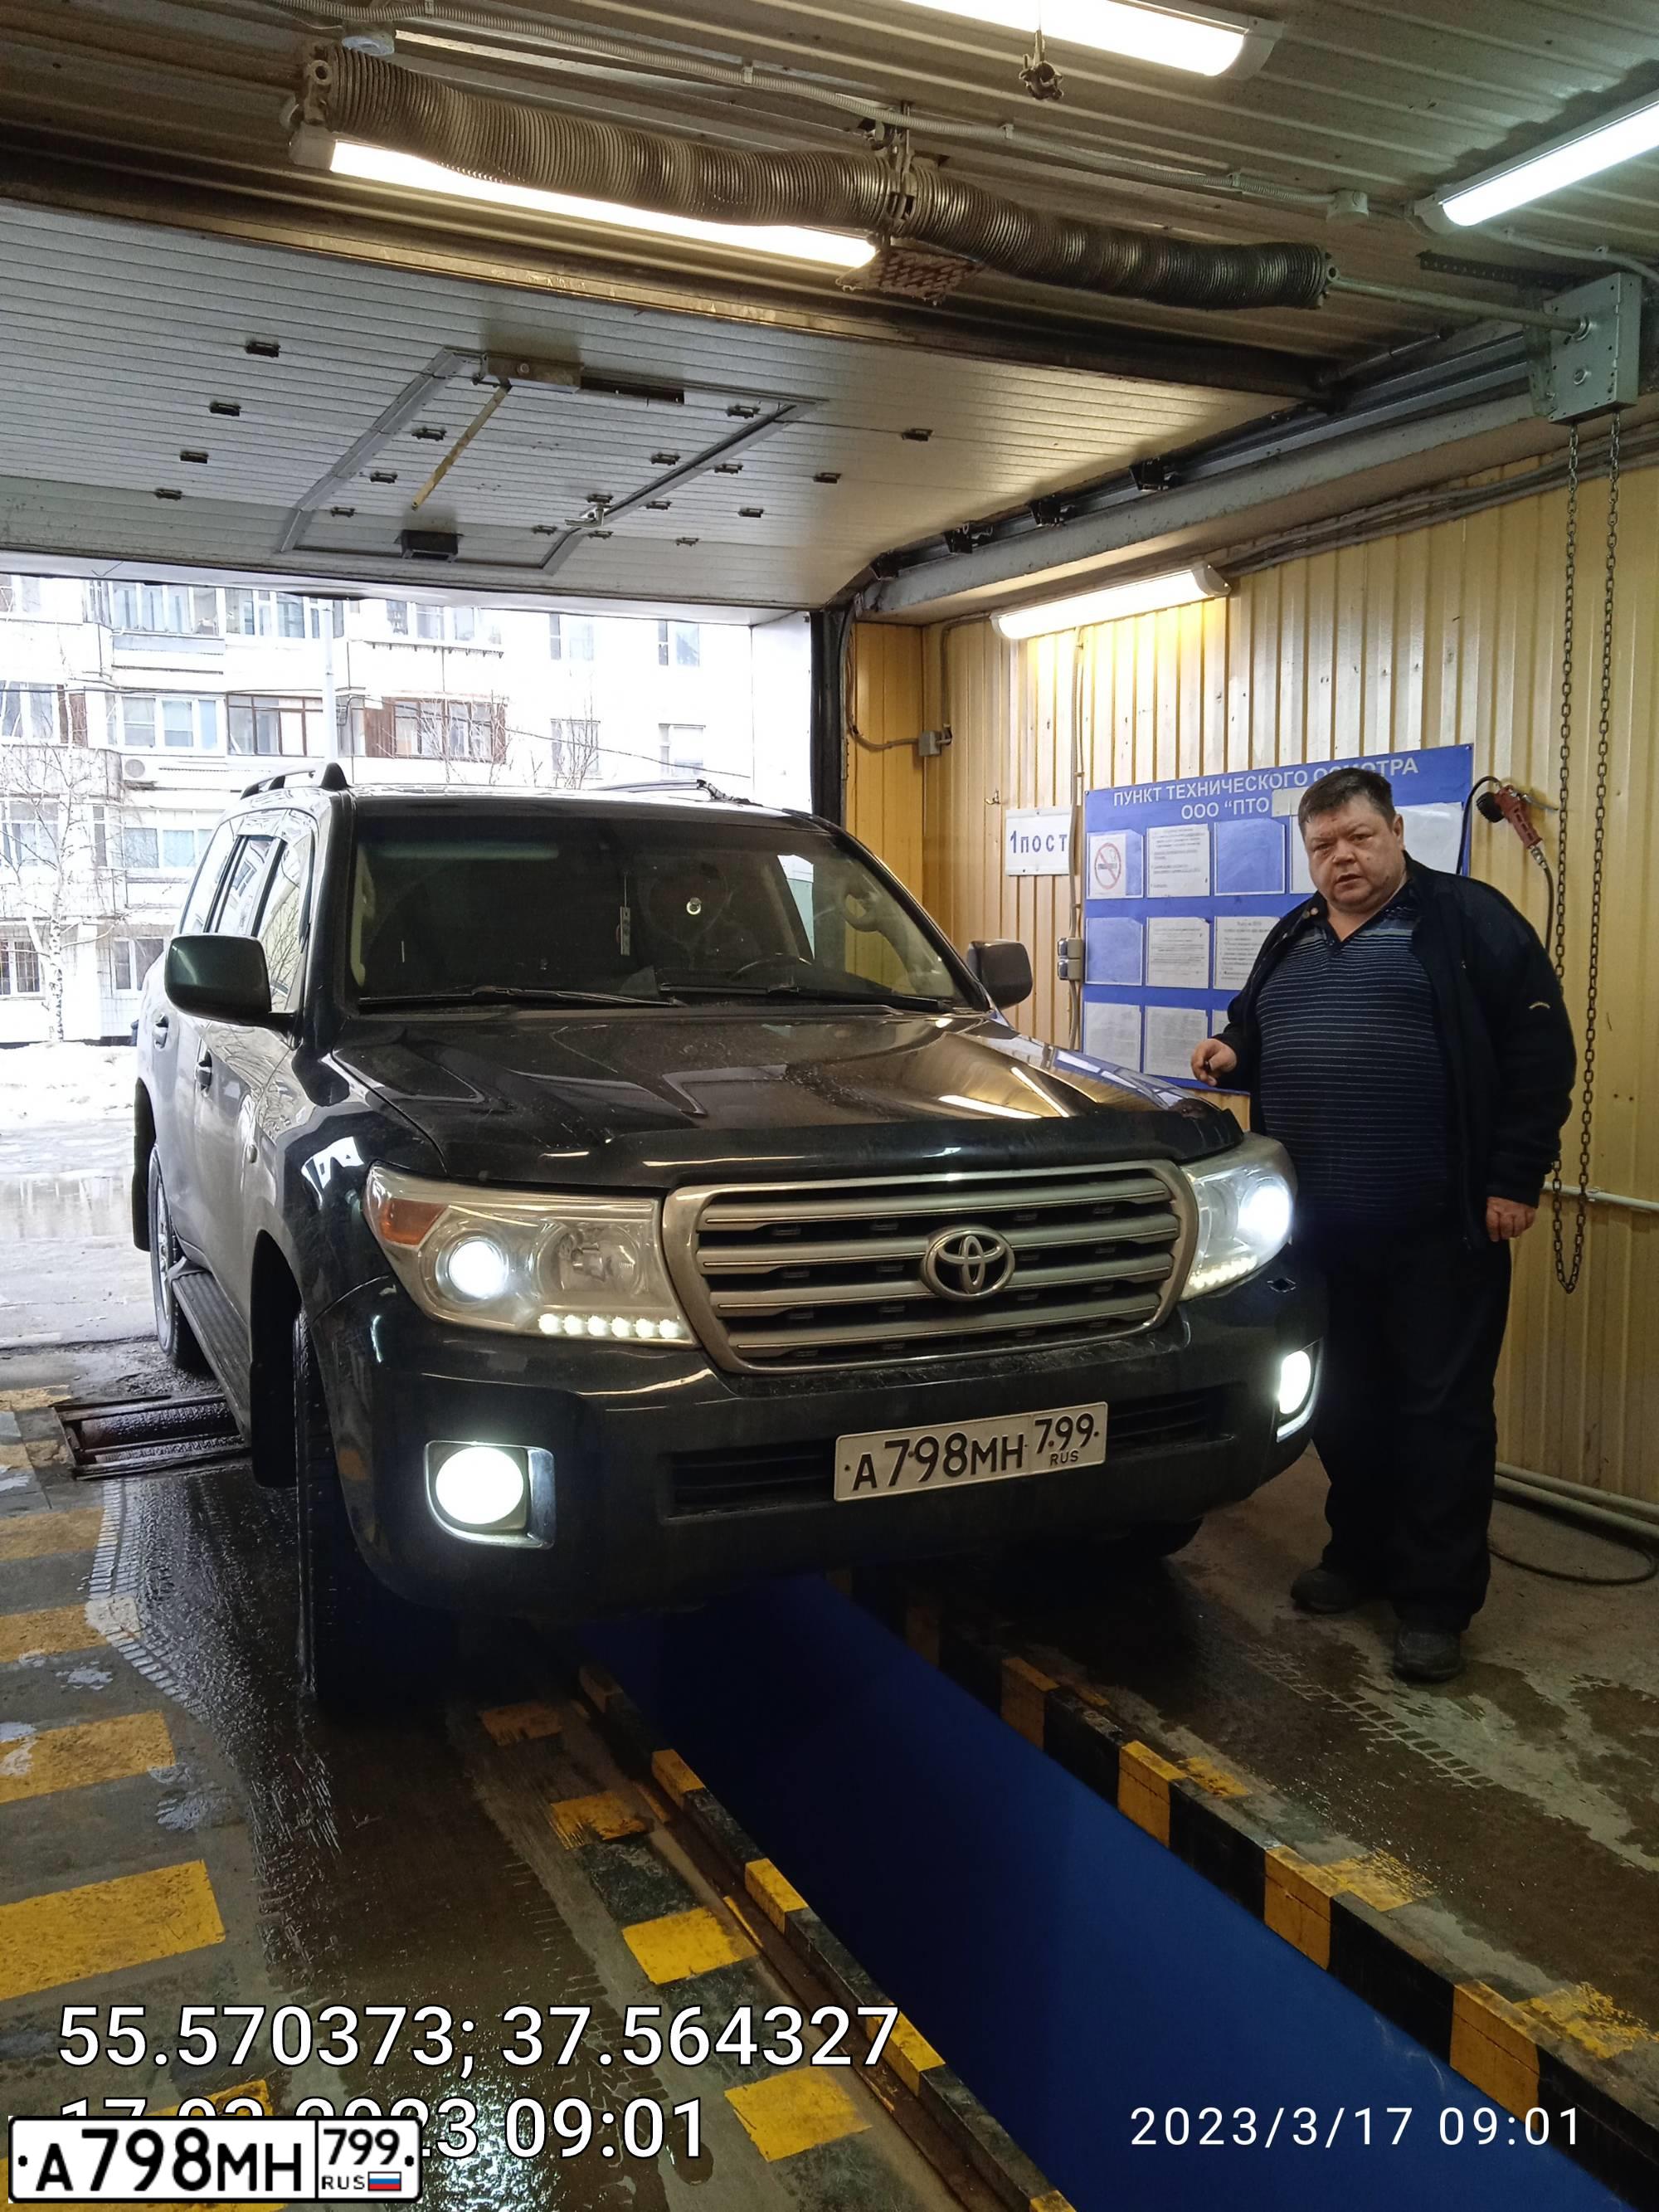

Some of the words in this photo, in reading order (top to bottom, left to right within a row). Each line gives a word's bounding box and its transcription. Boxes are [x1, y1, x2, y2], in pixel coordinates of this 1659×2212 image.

[1113, 787, 1162, 807] ПУНКТ
[1166, 769, 1307, 801] ТЕХНИЧЕСКОГО
[1180, 802, 1219, 821] ООО
[1034, 1412, 1095, 1454] 799
[1049, 1449, 1079, 1466] RUS
